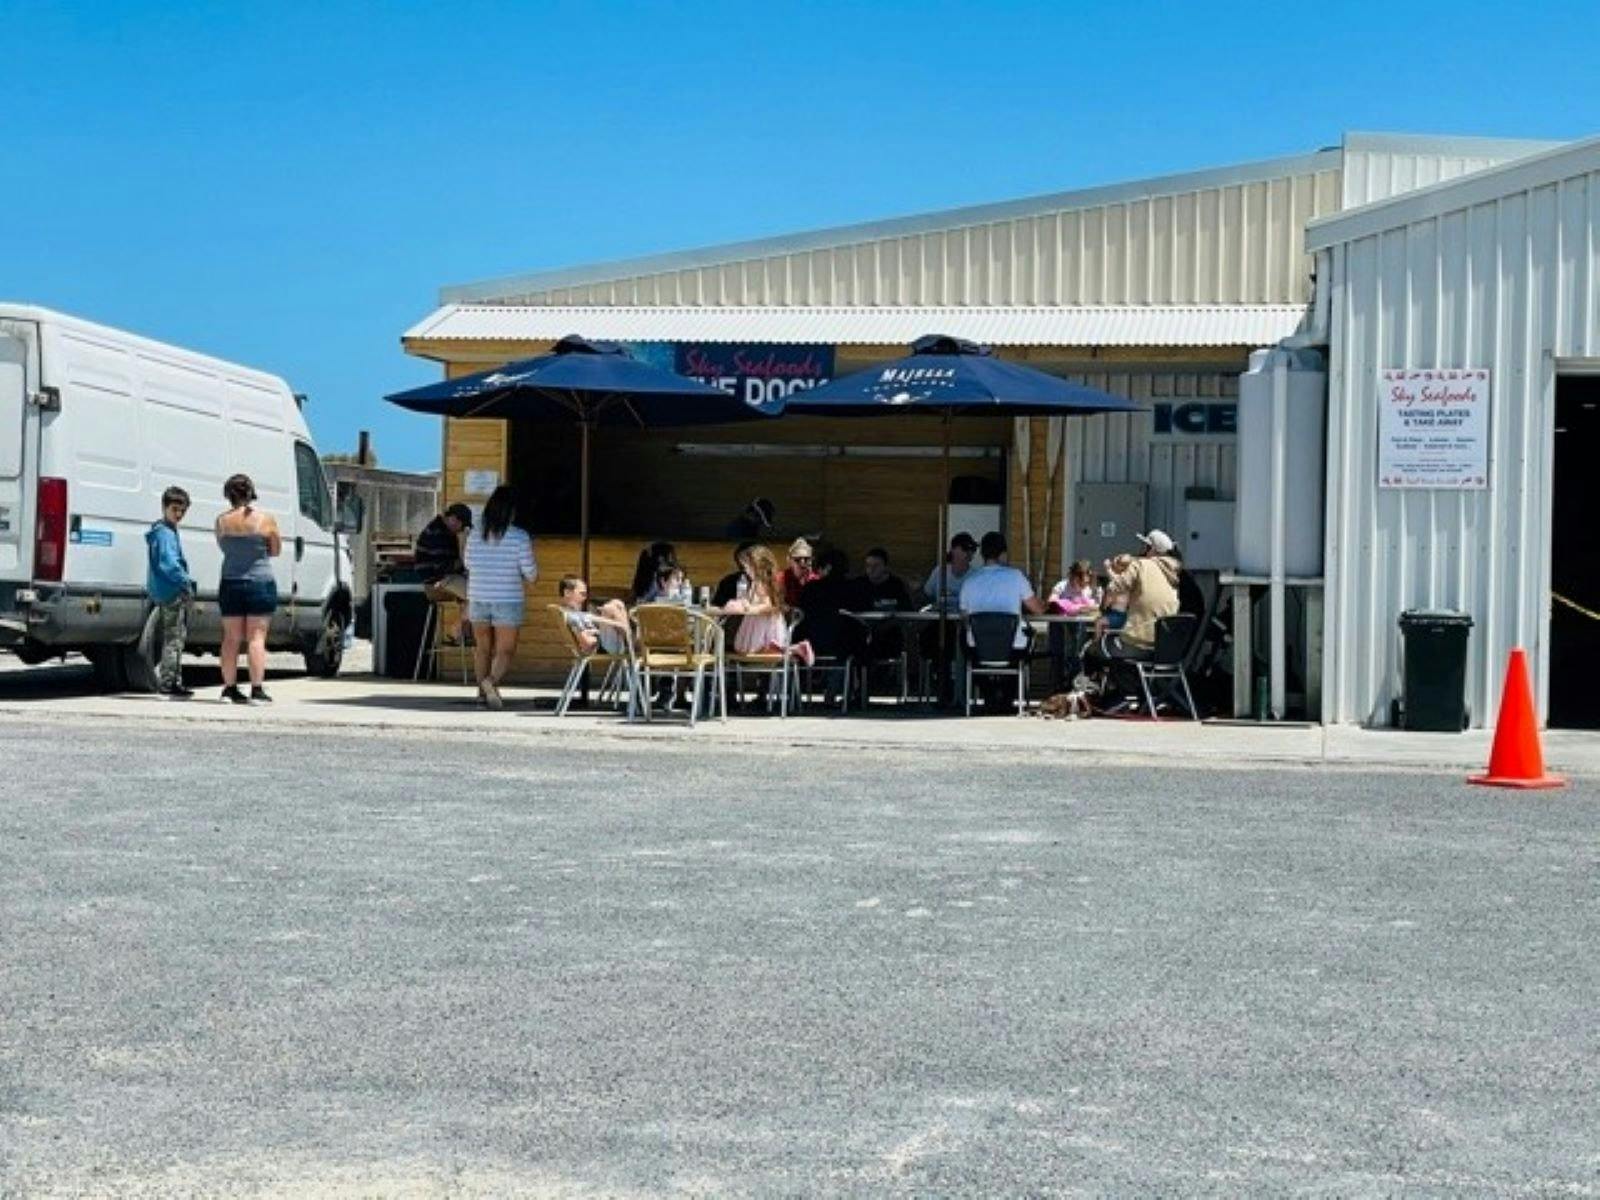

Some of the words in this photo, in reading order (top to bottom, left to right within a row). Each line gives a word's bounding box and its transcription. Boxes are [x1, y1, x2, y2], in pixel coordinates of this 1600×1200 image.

[734, 352, 821, 378] Seafoods
[746, 378, 829, 405] DOC
[1420, 386, 1477, 407] Seafoods
[1154, 403, 1237, 434] ICE
[1437, 409, 1470, 418] PLATES
